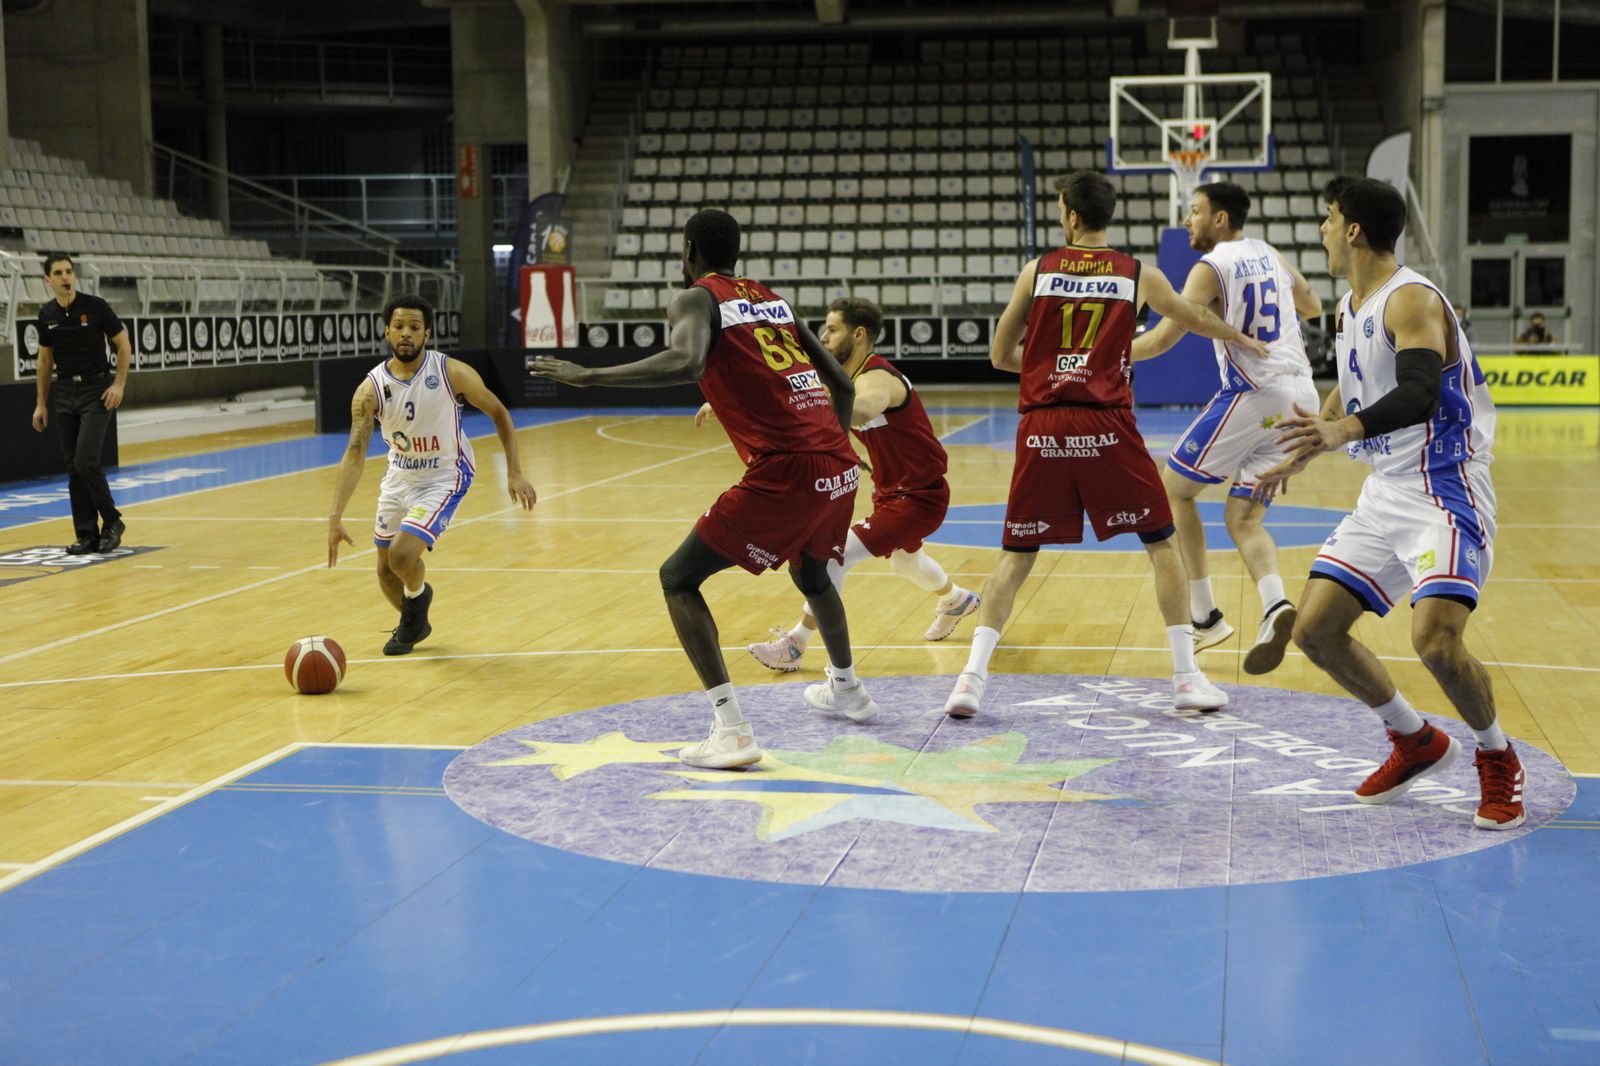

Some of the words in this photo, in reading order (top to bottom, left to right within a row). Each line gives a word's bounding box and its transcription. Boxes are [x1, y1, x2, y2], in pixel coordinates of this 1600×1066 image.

[1050, 277, 1118, 294] PULEVA
[737, 303, 788, 319] PUEVA
[1242, 277, 1281, 342] 15
[1060, 302, 1105, 349] 17
[1349, 348, 1363, 382] 4
[405, 401, 415, 421] 3
[412, 435, 440, 452] HLA
[1026, 435, 1060, 449] CAJA
[1065, 432, 1119, 448] RURAL
[1040, 448, 1101, 458] GRANADA
[815, 475, 841, 492] CAJA
[1007, 521, 1037, 529] Granada
[1116, 511, 1137, 525] stg
[1012, 528, 1037, 538] Digital
